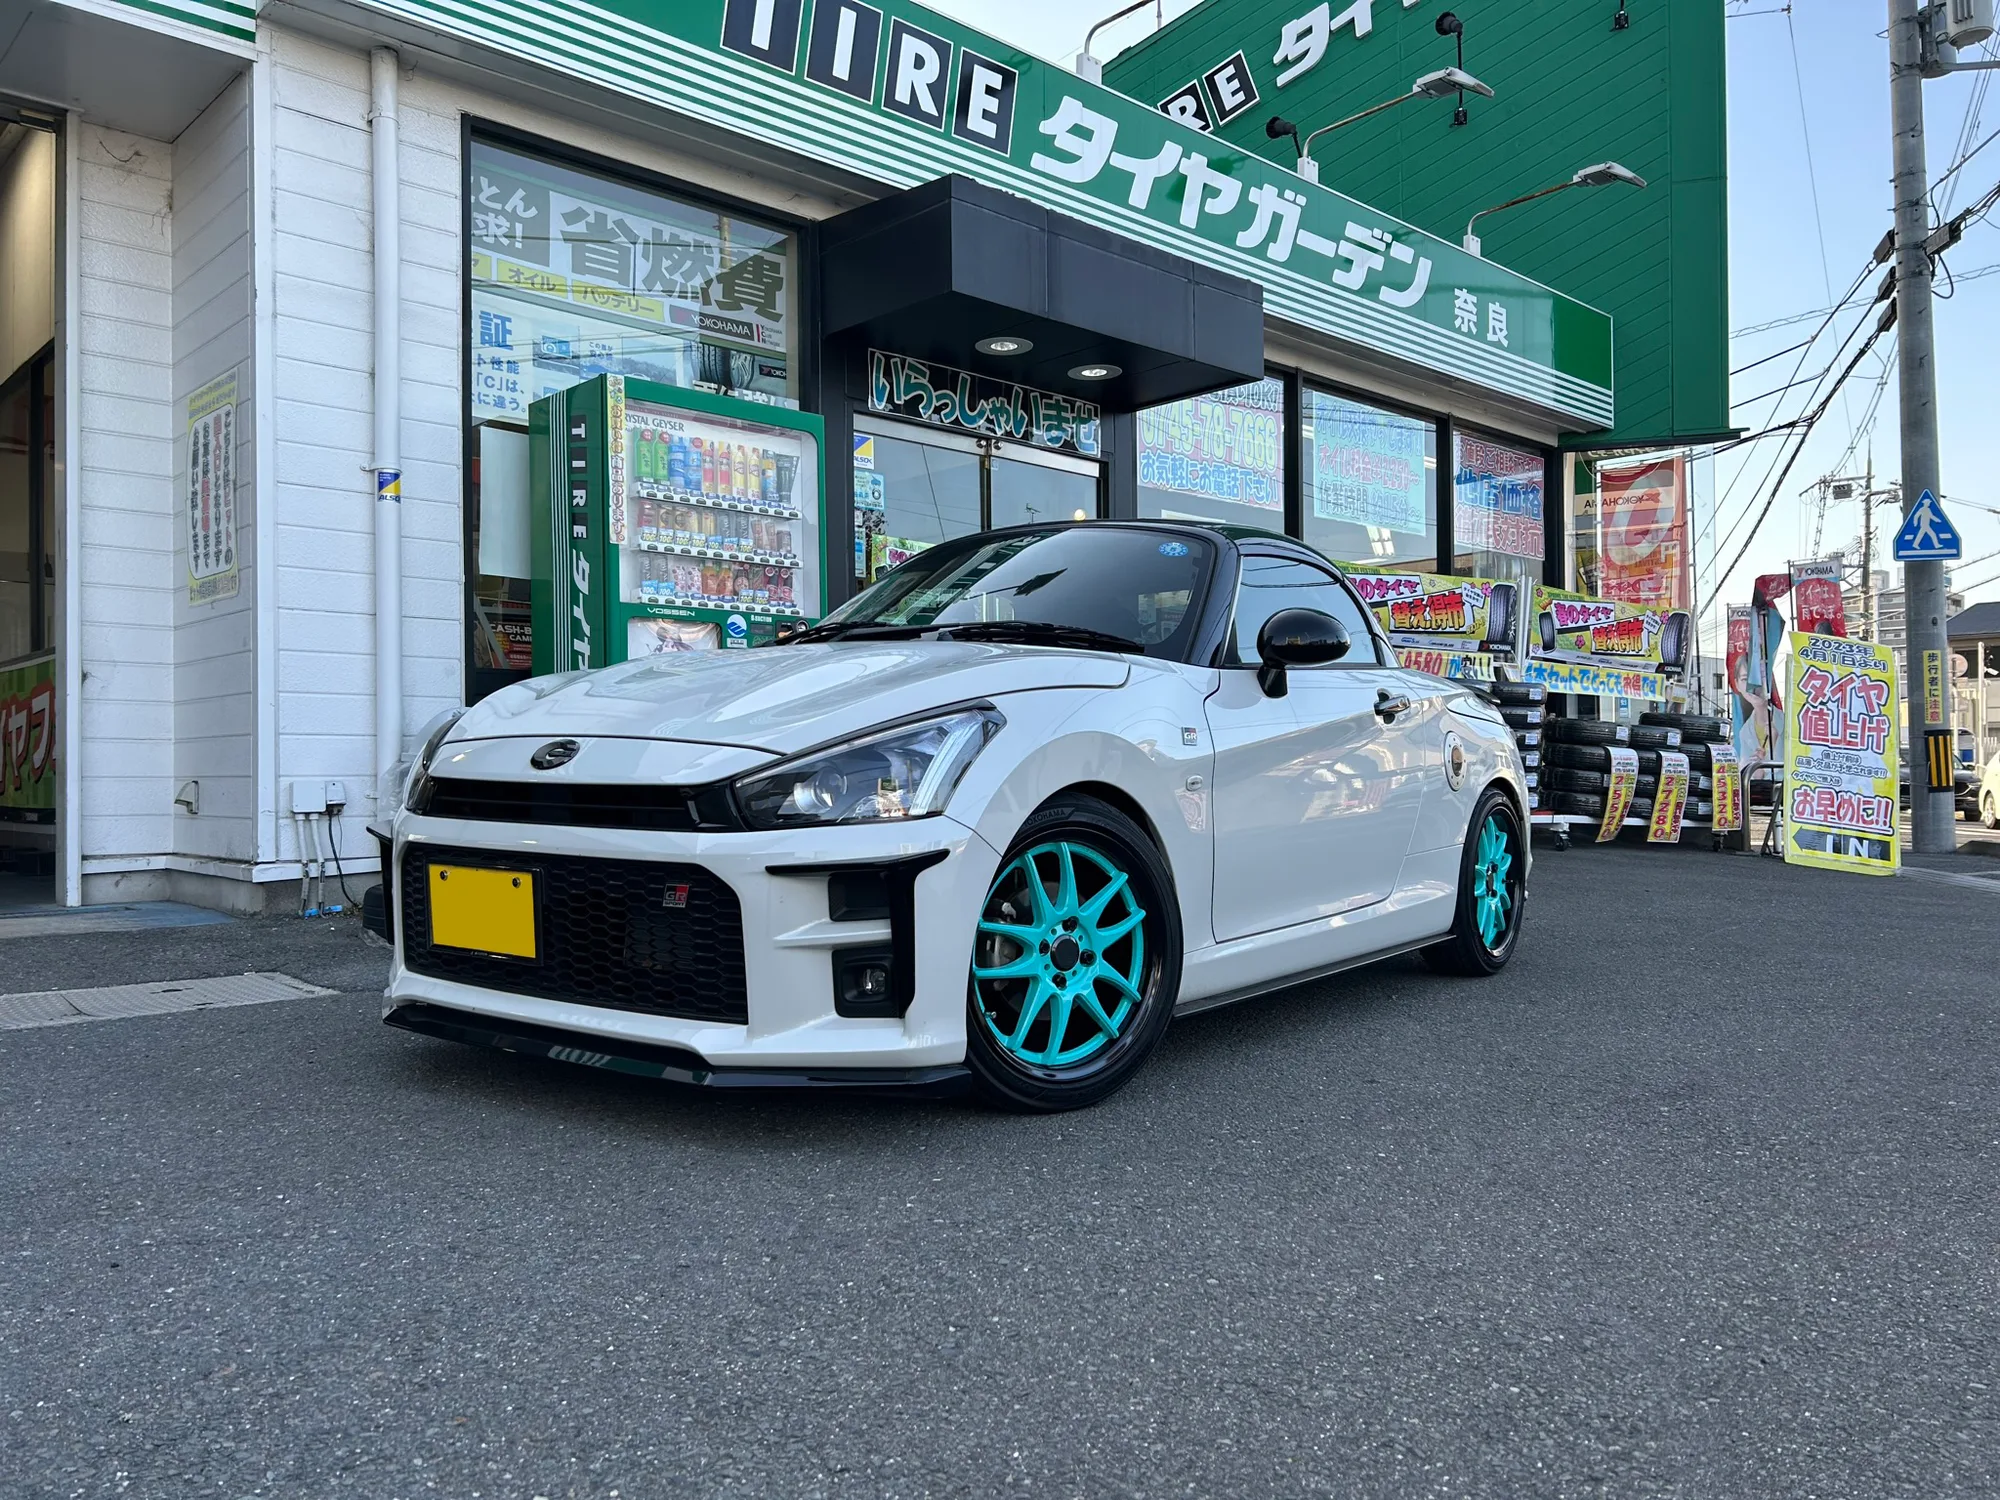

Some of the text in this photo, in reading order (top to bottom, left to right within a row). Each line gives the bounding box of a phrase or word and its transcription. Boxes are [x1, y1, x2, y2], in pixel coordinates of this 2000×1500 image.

[1273, 0, 1420, 89] タイ
[471, 175, 539, 219] とん
[1030, 95, 1433, 310] タイヤガーデン
[508, 267, 557, 292] オイル
[560, 204, 784, 323] 省燃費
[582, 286, 656, 316] バッテリー
[1453, 288, 1510, 349] 奈良
[478, 310, 514, 351] 証
[691, 314, 751, 337] YOKOHAMA
[873, 352, 1100, 456] いらっしゃいませ
[652, 417, 685, 433] GEYSER
[571, 423, 587, 540] TIRE
[1141, 449, 1279, 504] お気軽にお電話下さい
[1456, 465, 1542, 520] 他店価格
[647, 607, 696, 617] VOSSEN
[1391, 591, 1466, 631] 替え得市
[1554, 601, 1614, 627] 春のタイヤ
[1592, 618, 1645, 654] 替え得市
[1809, 636, 1875, 657] 2023年
[1799, 646, 1888, 673] 4月1日より
[1798, 666, 1889, 715] タイヤ
[1927, 652, 1940, 721] 歩行者に注意
[0, 688, 56, 784] ヤフ
[1799, 704, 1889, 753] 値上げ
[1794, 787, 1893, 828] お早めに!!
[1826, 834, 1869, 859] IN
[665, 891, 687, 902] GR
